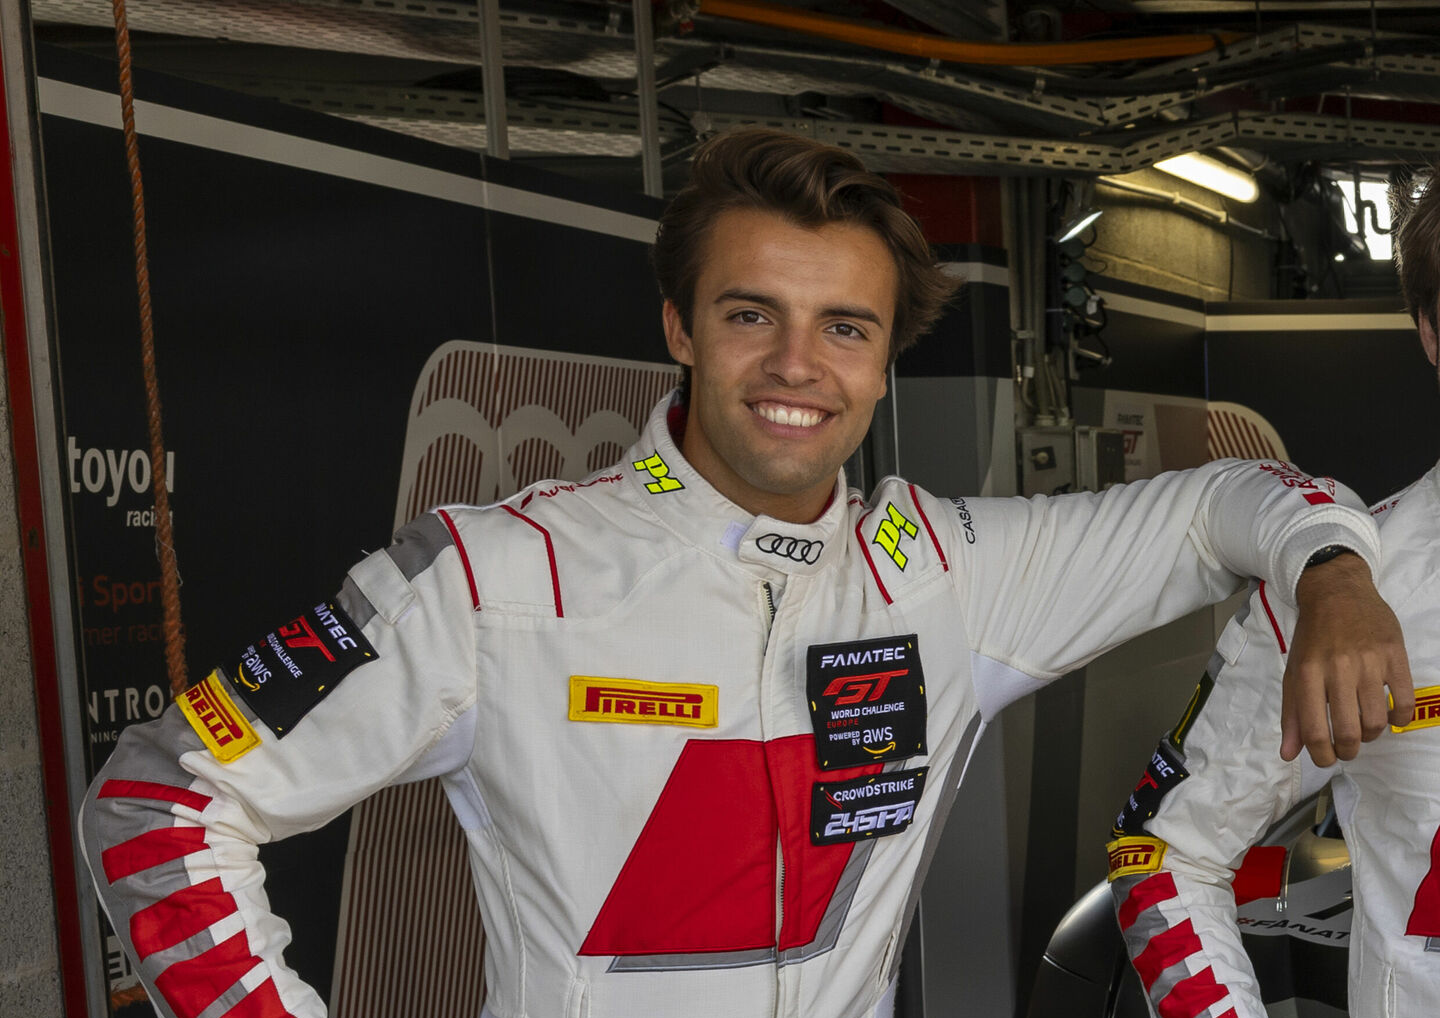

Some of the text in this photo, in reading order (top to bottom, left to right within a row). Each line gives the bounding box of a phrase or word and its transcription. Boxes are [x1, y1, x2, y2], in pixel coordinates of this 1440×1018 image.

[126, 505, 173, 528] raci
[93, 574, 166, 613] Spor
[314, 602, 358, 650] NATEC
[821, 647, 905, 668] FANATEC
[822, 669, 909, 705] GT
[88, 684, 174, 725] NTRO
[185, 677, 244, 747] RELLI
[585, 686, 703, 719] PIRELLI
[831, 702, 905, 720] WORLD CHALLENGE
[829, 731, 861, 741] POWERED
[863, 727, 893, 744] aws
[833, 778, 914, 802] CROWDSTRIKE
[1249, 918, 1352, 940] FANAT
